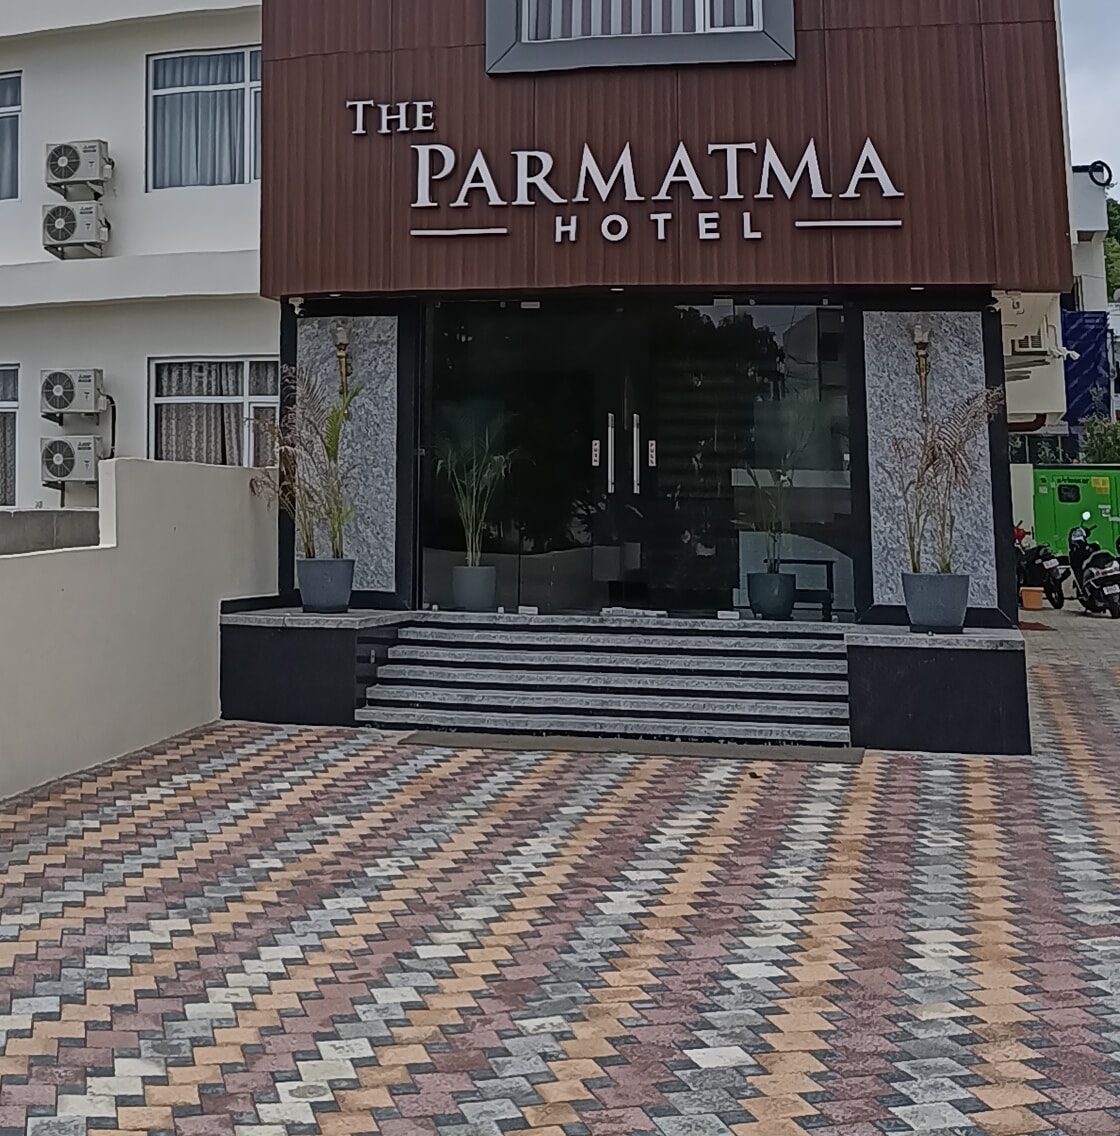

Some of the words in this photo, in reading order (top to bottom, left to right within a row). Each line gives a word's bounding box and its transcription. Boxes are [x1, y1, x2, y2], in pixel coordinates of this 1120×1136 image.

[346, 99, 435, 135] THE
[410, 137, 904, 207] PARMATMA
[555, 212, 762, 243] HOTEL
